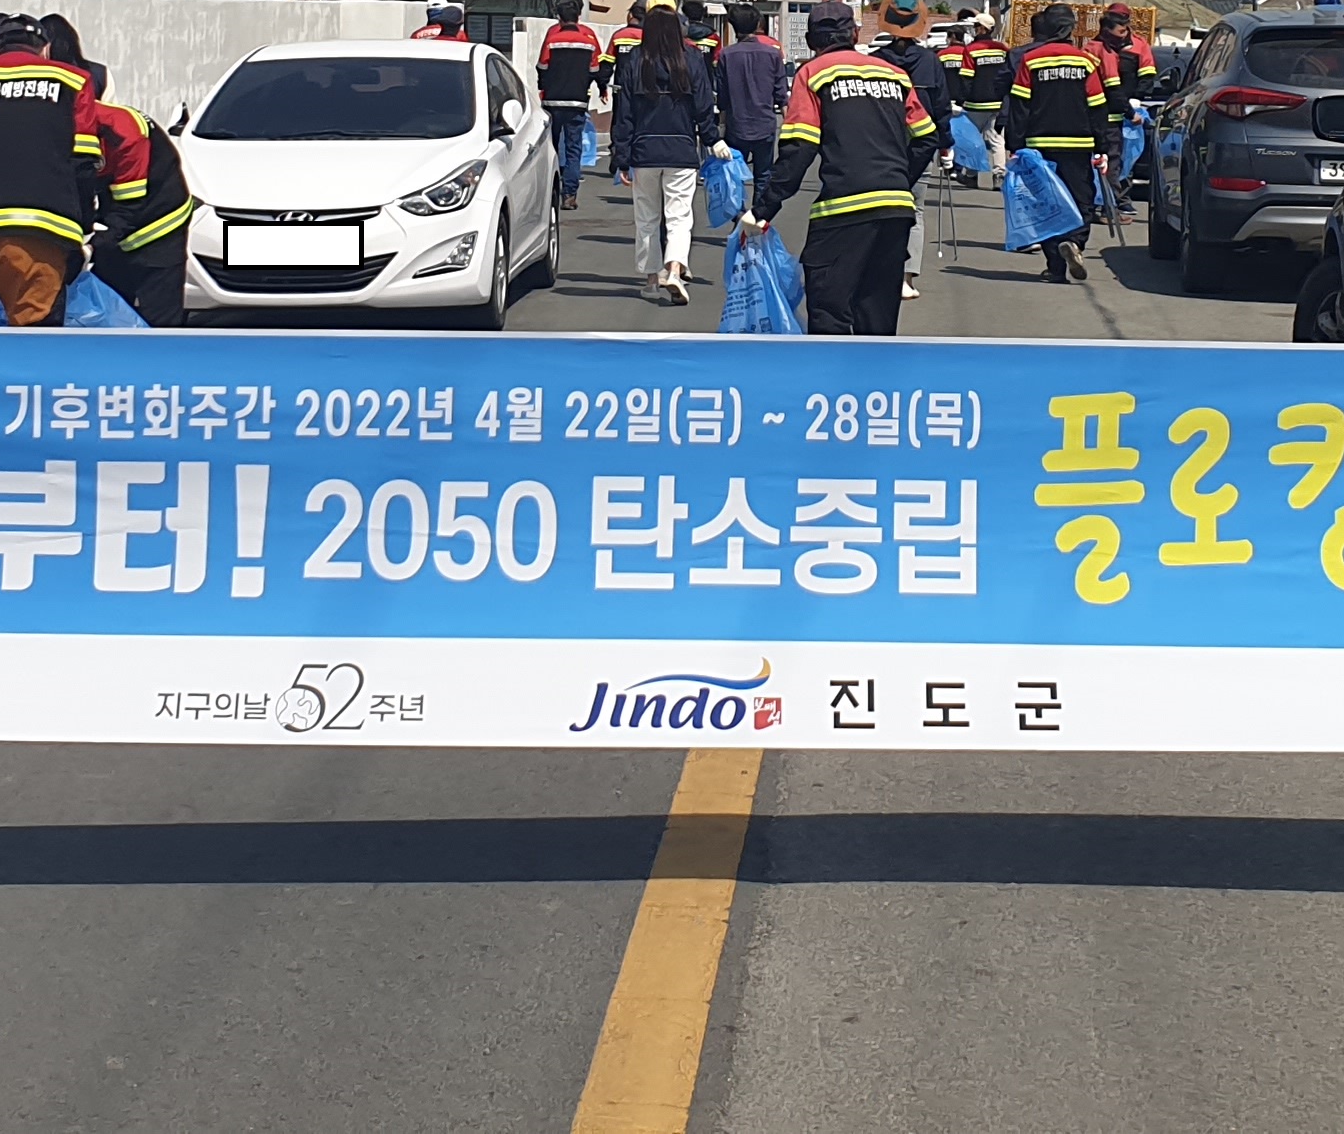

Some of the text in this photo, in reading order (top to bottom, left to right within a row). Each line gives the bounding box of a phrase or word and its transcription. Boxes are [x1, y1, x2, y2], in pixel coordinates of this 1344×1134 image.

[5, 384, 276, 440] 기후변화주간
[295, 387, 453, 440] 2022년
[475, 387, 543, 442] 4월
[565, 387, 742, 446] 22일(금)
[805, 390, 981, 449] 28일(목)
[303, 479, 557, 582] 2050
[590, 475, 977, 595] 탄소중립
[154, 690, 270, 720] 지구의날
[569, 681, 746, 732] Jindo
